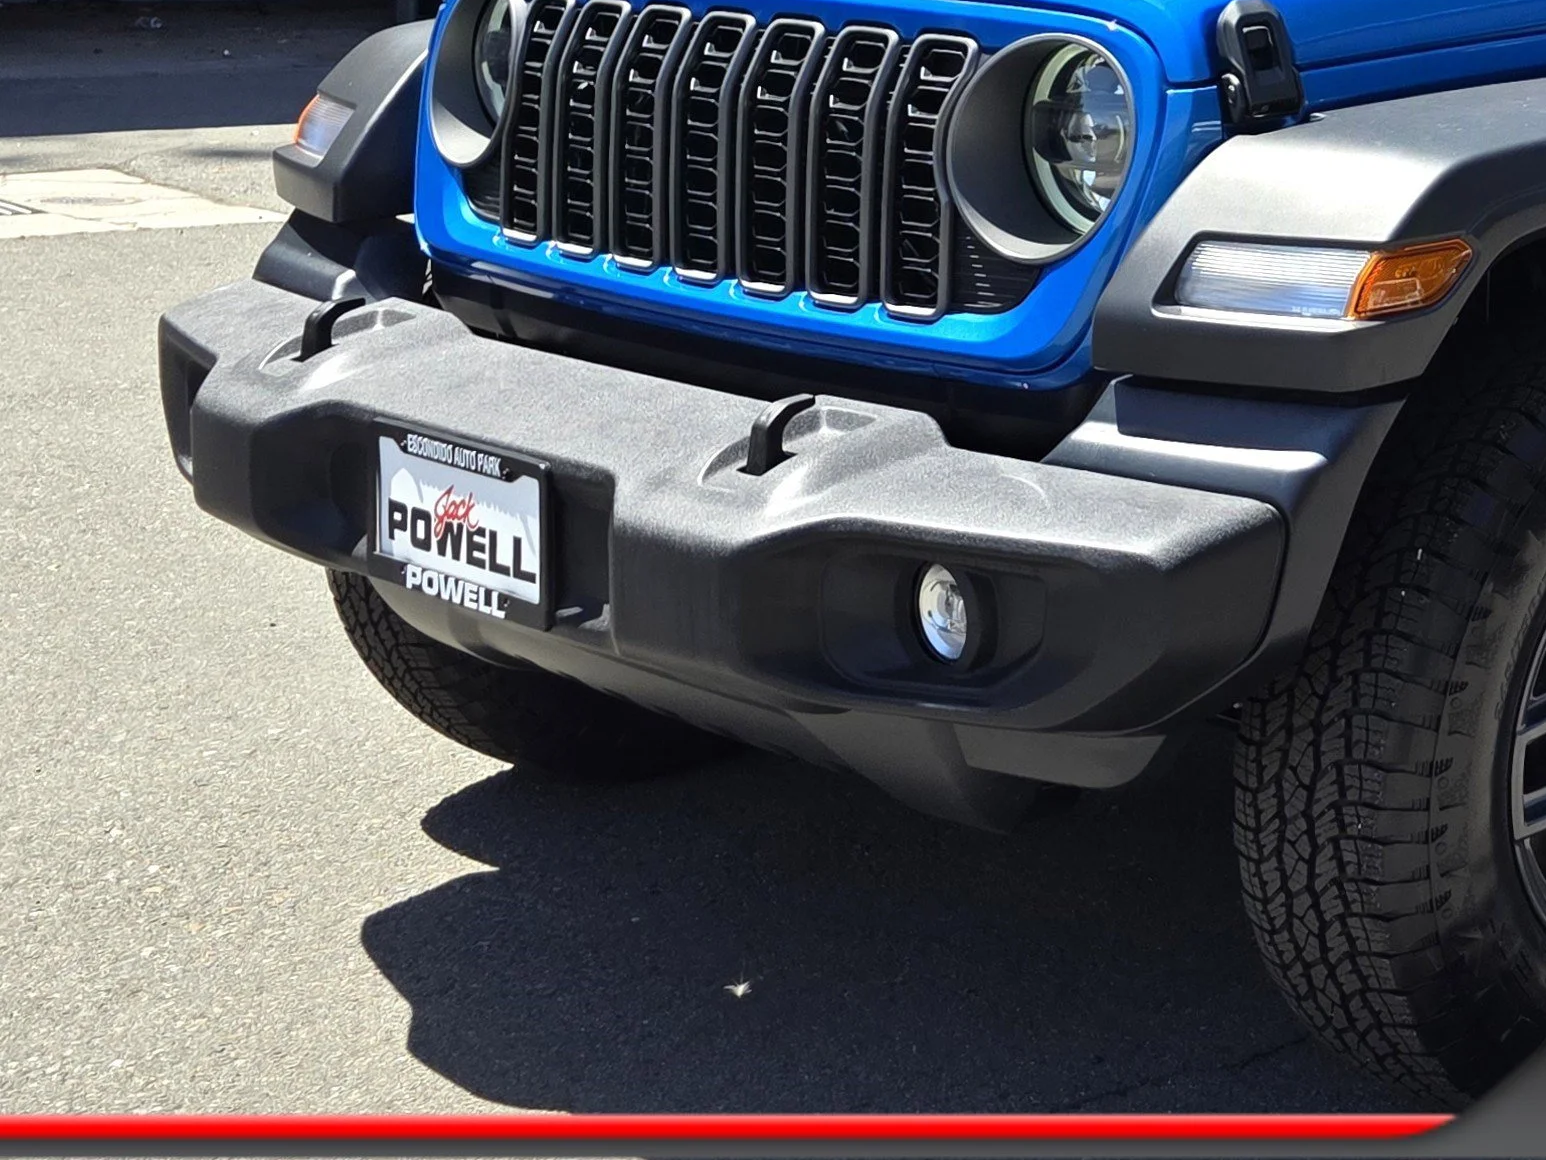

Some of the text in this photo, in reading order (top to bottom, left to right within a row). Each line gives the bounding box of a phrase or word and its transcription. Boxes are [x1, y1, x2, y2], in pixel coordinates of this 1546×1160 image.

[406, 433, 502, 479] ESCONDIDO AUTO PARK
[434, 485, 480, 539] Jack
[388, 497, 537, 585] POWELL
[406, 564, 507, 620] POWELL
